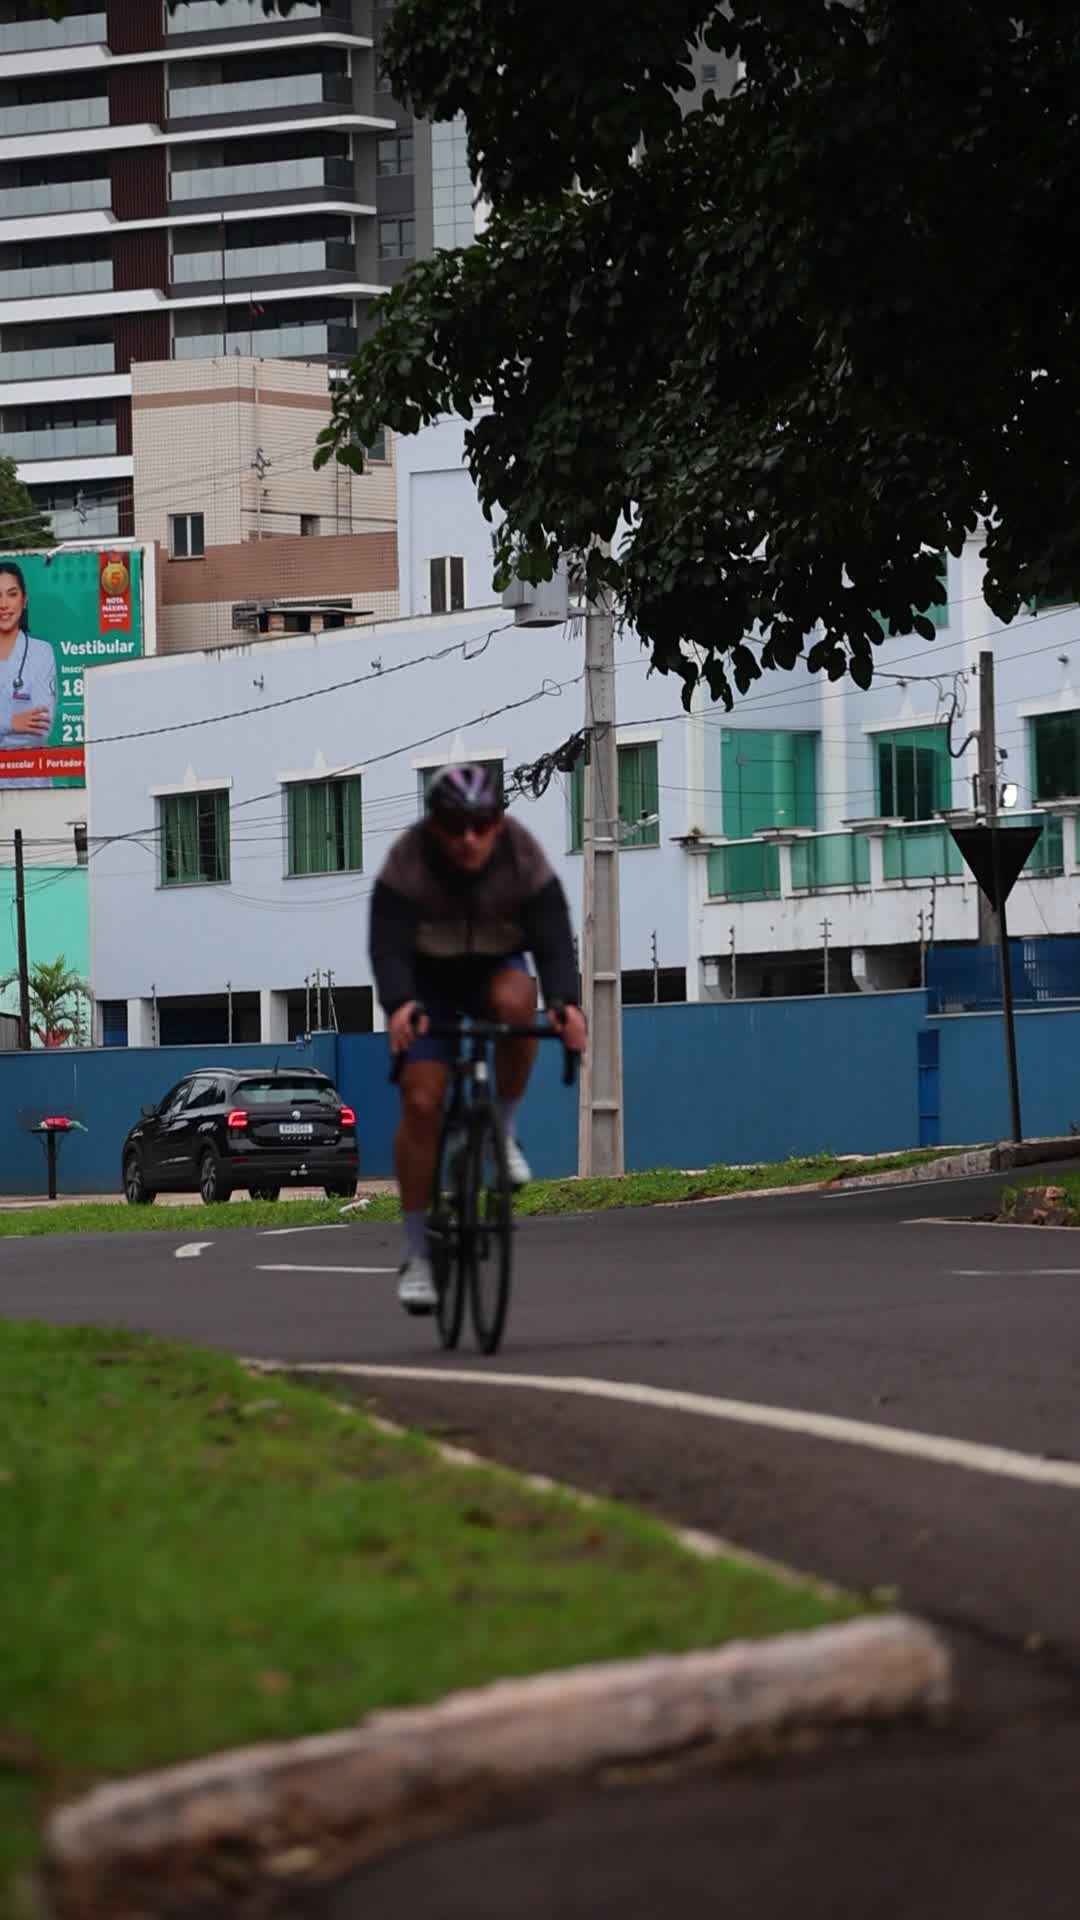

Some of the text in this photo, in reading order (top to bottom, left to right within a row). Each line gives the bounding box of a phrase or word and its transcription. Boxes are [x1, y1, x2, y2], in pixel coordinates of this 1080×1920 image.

[60, 639, 135, 656] Vestibular
[62, 679, 84, 697] 18
[62, 724, 84, 742] 21
